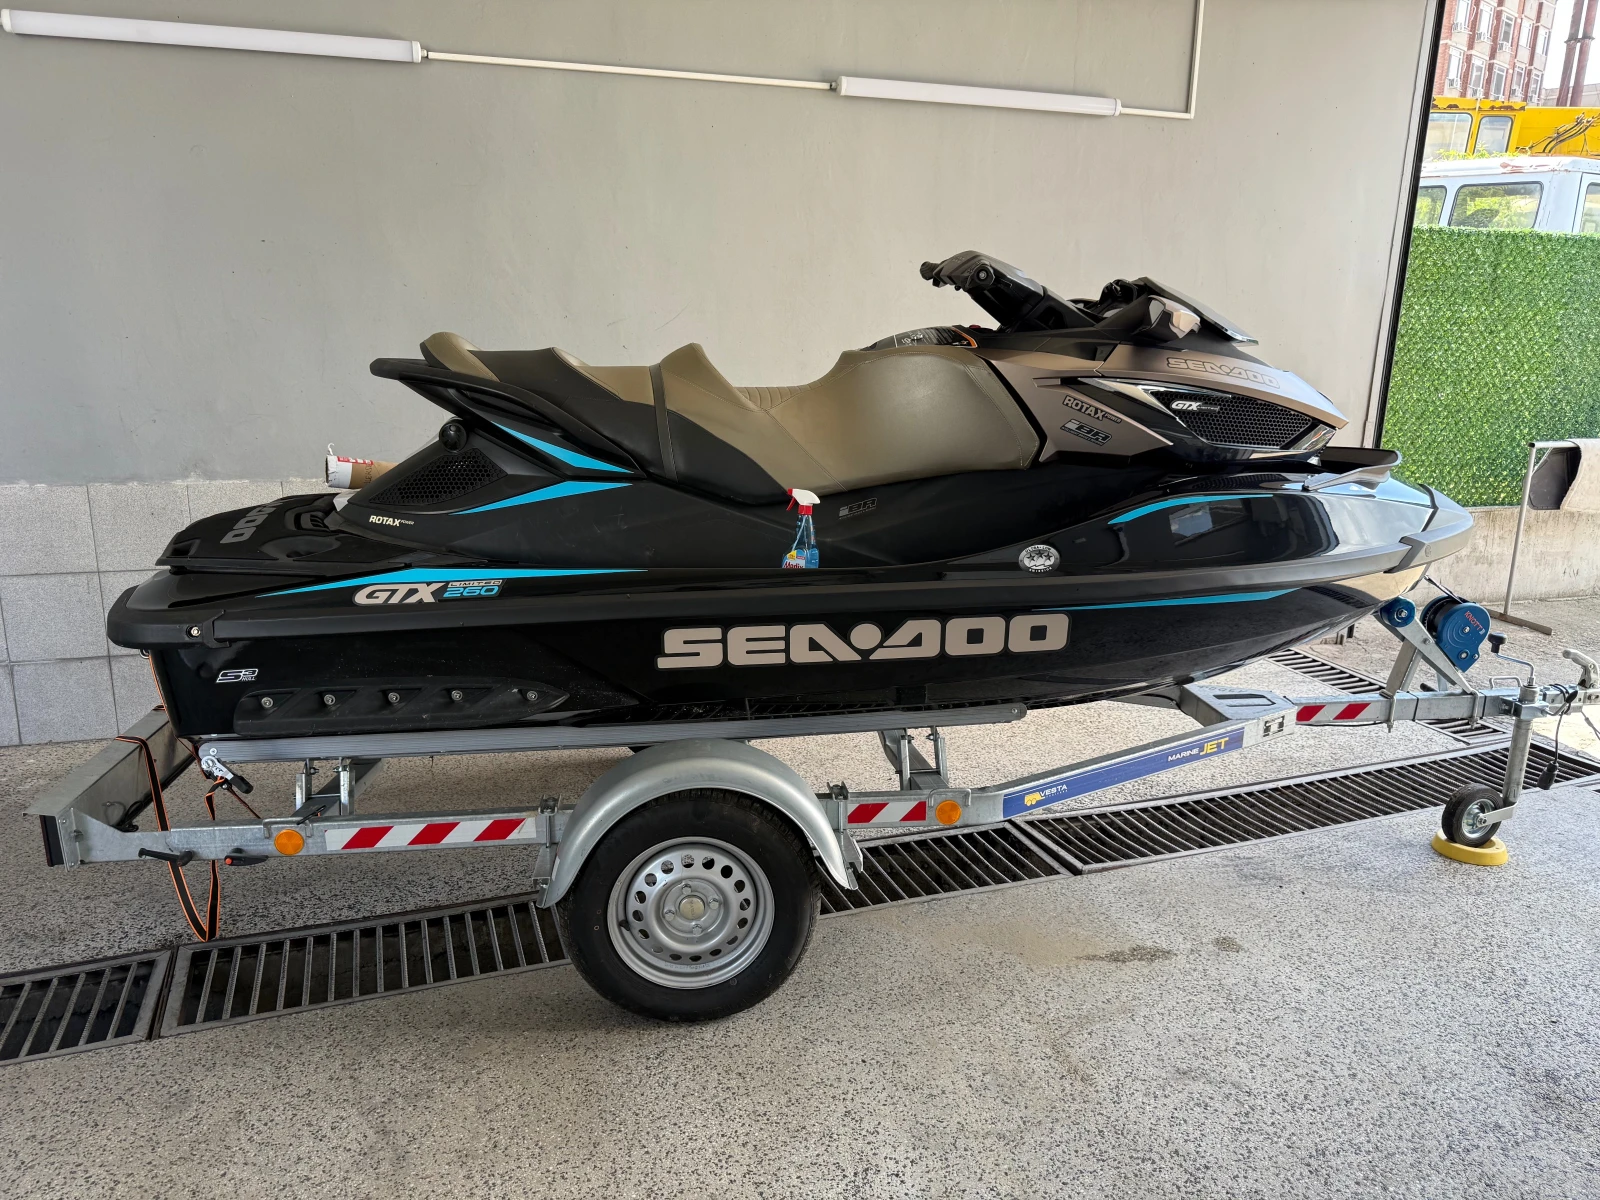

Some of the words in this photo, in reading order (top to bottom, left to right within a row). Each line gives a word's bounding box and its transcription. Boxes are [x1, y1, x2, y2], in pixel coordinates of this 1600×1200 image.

[1062, 395, 1105, 421] ROTAX
[1171, 400, 1202, 411] GTX
[369, 515, 401, 527] ROTAX
[354, 582, 446, 604] GTX
[443, 585, 499, 598] 260
[1464, 611, 1483, 631] KNOTT
[1168, 748, 1200, 762] MARINE
[1200, 738, 1229, 756] JET
[1040, 784, 1068, 799] VESTA
